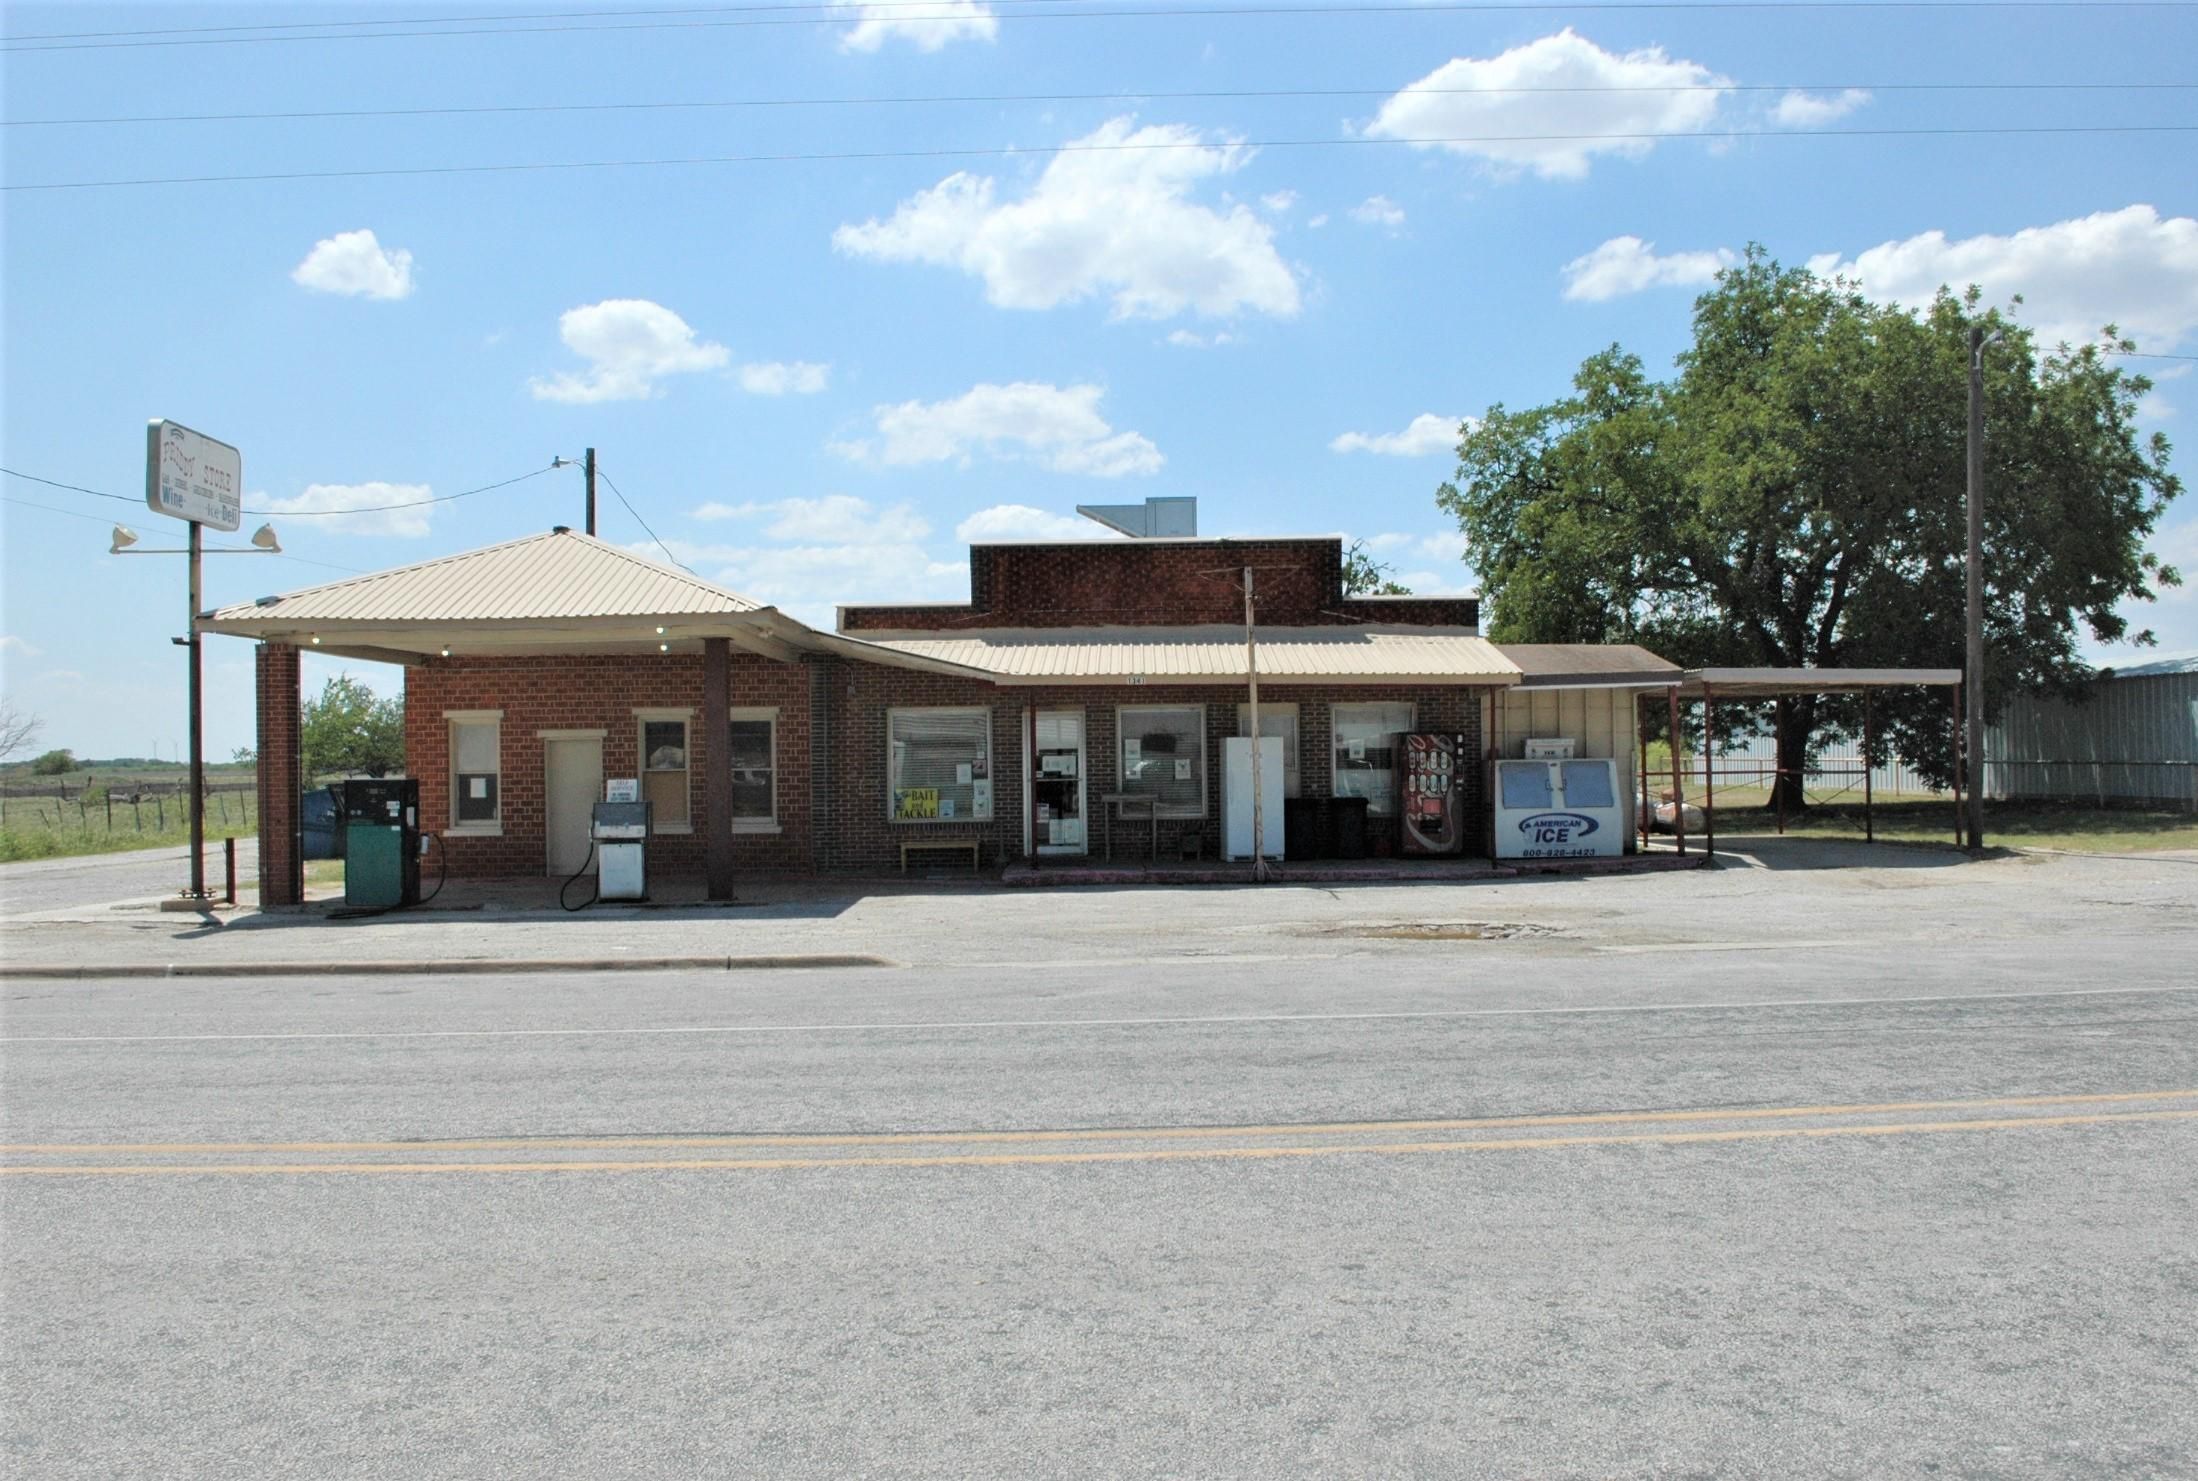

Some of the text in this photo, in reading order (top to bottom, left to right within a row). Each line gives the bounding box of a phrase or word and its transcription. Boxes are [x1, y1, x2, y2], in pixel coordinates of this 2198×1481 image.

[911, 790, 934, 801] BAIT
[898, 808, 936, 819] TACKLE
[1534, 820, 1581, 828] AMERICAN
[1535, 828, 1569, 843] ICE
